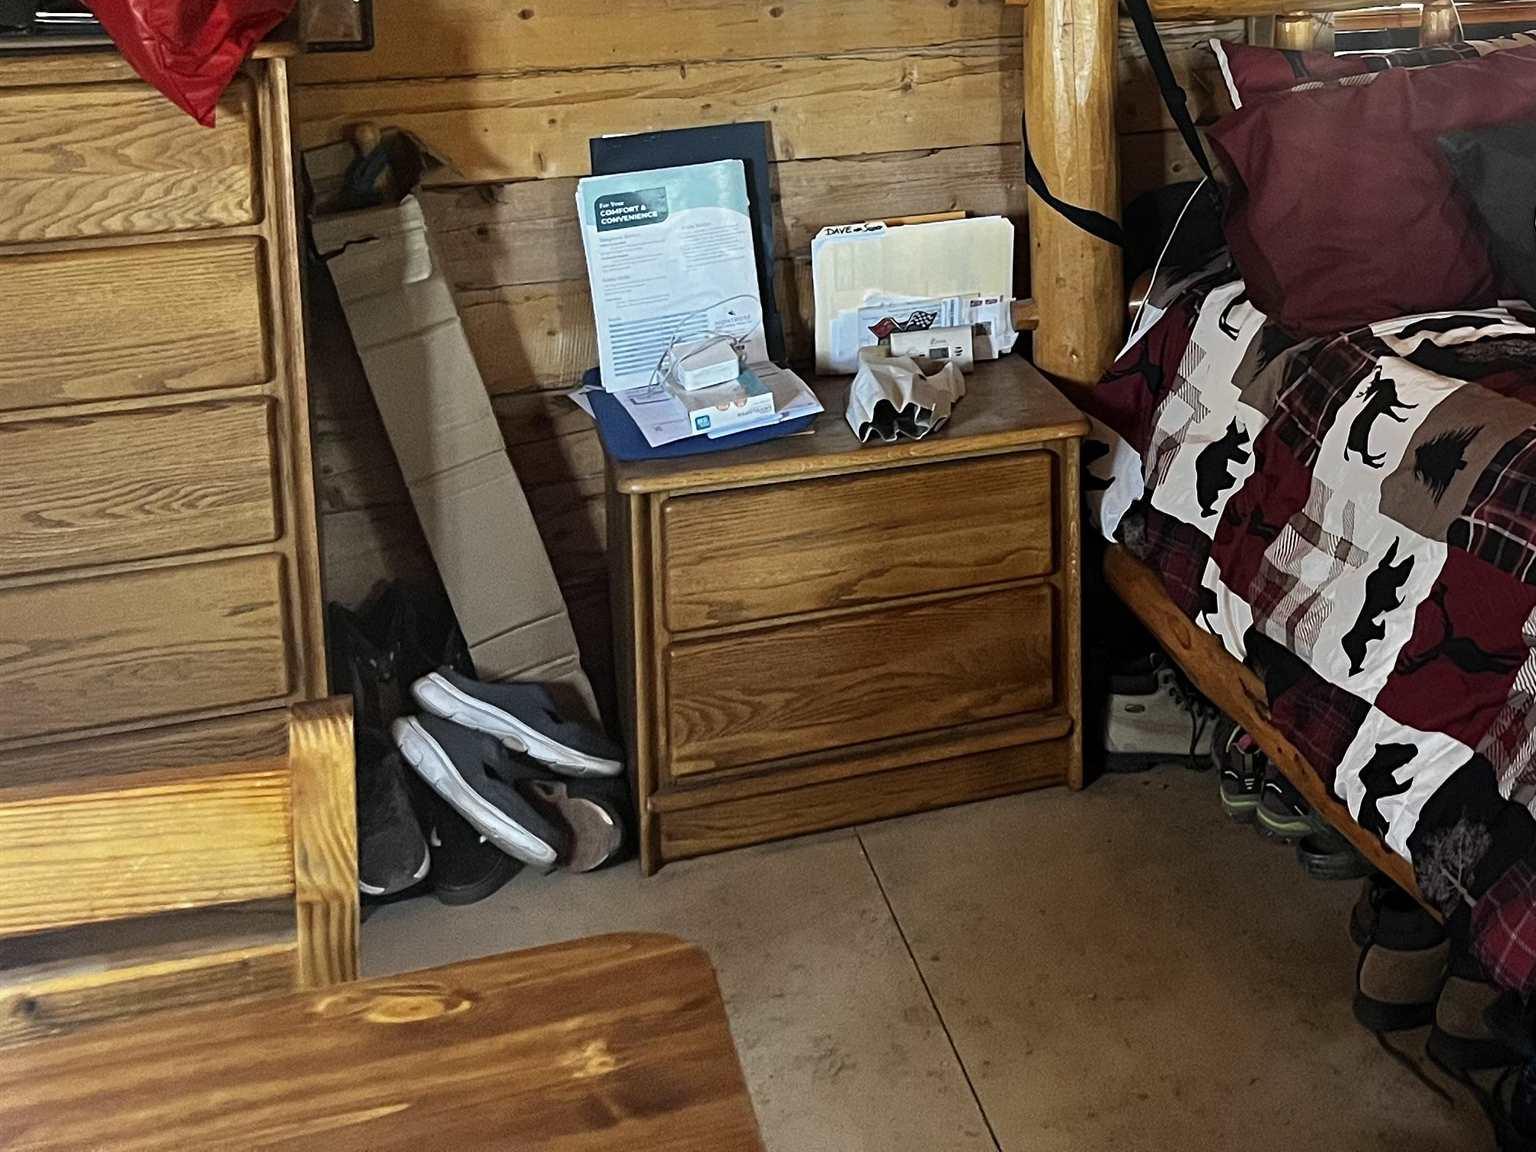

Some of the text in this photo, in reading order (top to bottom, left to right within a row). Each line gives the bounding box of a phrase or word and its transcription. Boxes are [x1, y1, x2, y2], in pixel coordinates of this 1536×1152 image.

[600, 205, 640, 218] COMFORT
[601, 210, 659, 225] CONVENIENCE
[824, 226, 853, 236] DAVE
